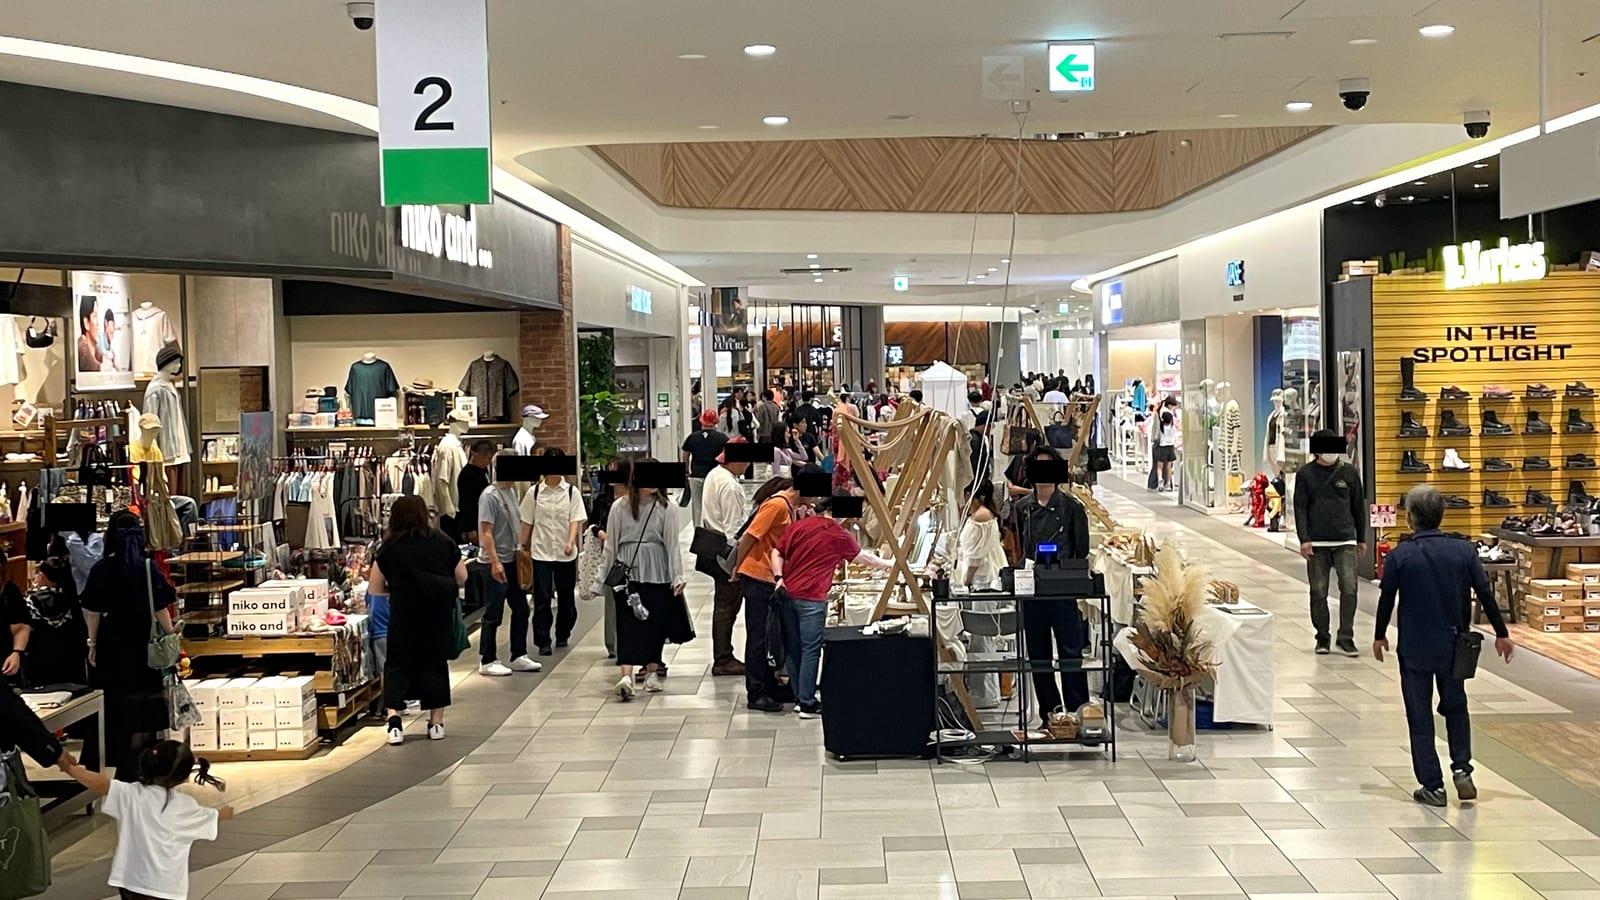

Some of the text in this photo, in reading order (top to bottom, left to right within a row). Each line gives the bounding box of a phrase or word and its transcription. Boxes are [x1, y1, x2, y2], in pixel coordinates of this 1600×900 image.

[413, 77, 455, 131] 2
[401, 204, 442, 257] niko
[1446, 325, 1537, 341] IN THE
[1413, 344, 1572, 363] SPOTLIGHT
[232, 599, 286, 610] niko and
[231, 620, 283, 631] niko and
